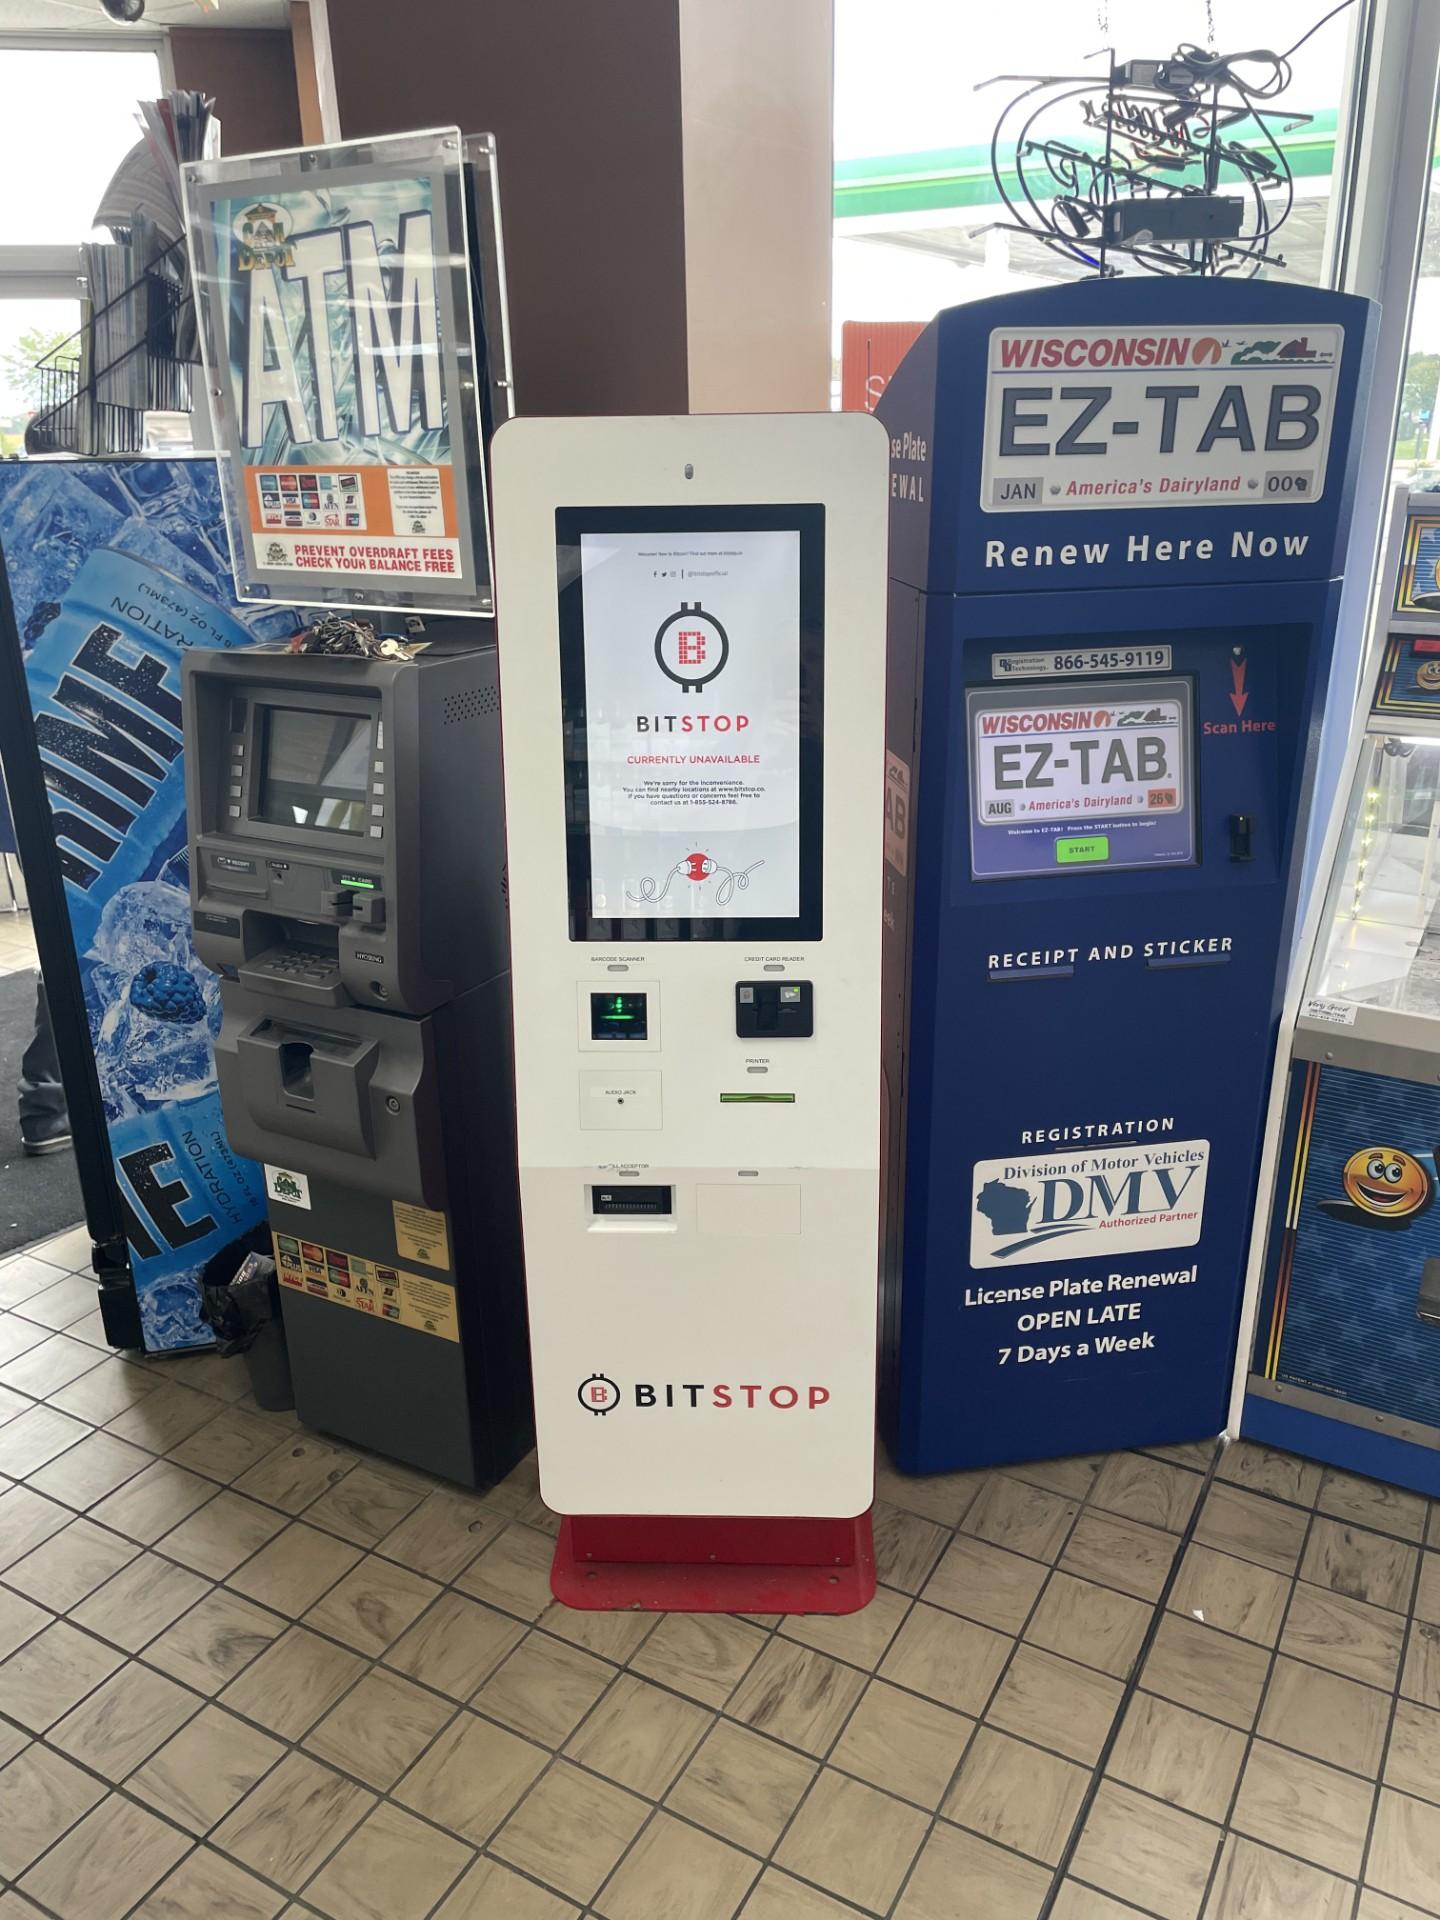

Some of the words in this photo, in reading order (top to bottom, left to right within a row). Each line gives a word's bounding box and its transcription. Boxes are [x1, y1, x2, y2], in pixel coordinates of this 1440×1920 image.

[243, 210, 444, 448] ATM
[1000, 337, 1191, 369] WISCONSIN
[998, 384, 1322, 457] EZ-TAB
[903, 431, 927, 462] Plate
[1000, 482, 1036, 501] JAN
[1066, 478, 1152, 497] America's
[1159, 476, 1241, 497] Dairyland
[1267, 476, 1293, 493] 00
[294, 544, 345, 557] PREVENT
[350, 545, 418, 560] OVERDRAFT
[423, 548, 454, 561] FEES
[985, 540, 1109, 568] Renew
[1127, 535, 1213, 562] Here
[1231, 531, 1309, 558] Now
[296, 556, 332, 569] CHECK
[336, 557, 366, 571] YOUR
[370, 558, 422, 572] BALANCE
[425, 560, 455, 573] FREE
[189, 614, 208, 630] OZ
[1054, 650, 1164, 671] 866-545-9119
[636, 715, 749, 733] BITSTOP
[982, 711, 1093, 735] WISCONSIN
[1203, 721, 1238, 735] Scan
[1241, 719, 1277, 733] Here
[627, 755, 686, 765] CURRENTLY
[689, 755, 760, 764] UNAVAILABLE
[988, 801, 1012, 816] AUG
[1028, 797, 1080, 812] America's
[1083, 794, 1133, 808] Dairyland
[1068, 845, 1096, 855] START
[591, 955, 618, 963] BARCODE
[618, 955, 645, 963] SCANNER
[744, 955, 764, 963] CREDIT
[765, 955, 781, 963] CARD
[781, 955, 805, 963] READER
[988, 948, 1079, 969] RECEIPT
[1088, 944, 1134, 962] AND
[1143, 937, 1233, 957] STICKER
[1021, 1117, 1175, 1145] REGISTRATION
[1003, 1162, 1067, 1181] Division
[1071, 1159, 1088, 1174] of
[1090, 1156, 1139, 1173] Motor
[1143, 1150, 1205, 1167] Vehicles
[182, 1130, 242, 1225] HYDRATION
[1035, 1165, 1201, 1225] DMV
[1098, 1213, 1157, 1230] Authorized
[1159, 1210, 1199, 1225] Partner
[964, 1284, 1045, 1308] License
[1049, 1276, 1104, 1298] Plate
[1107, 1264, 1198, 1292] Renewal
[1016, 1308, 1081, 1333] OPEN
[1087, 1302, 1142, 1326] LATE
[998, 1348, 1012, 1366] 7
[1016, 1343, 1071, 1365] Days
[1076, 1343, 1090, 1357] a
[1094, 1331, 1156, 1355] Week
[635, 1384, 830, 1410] BITSTOP
